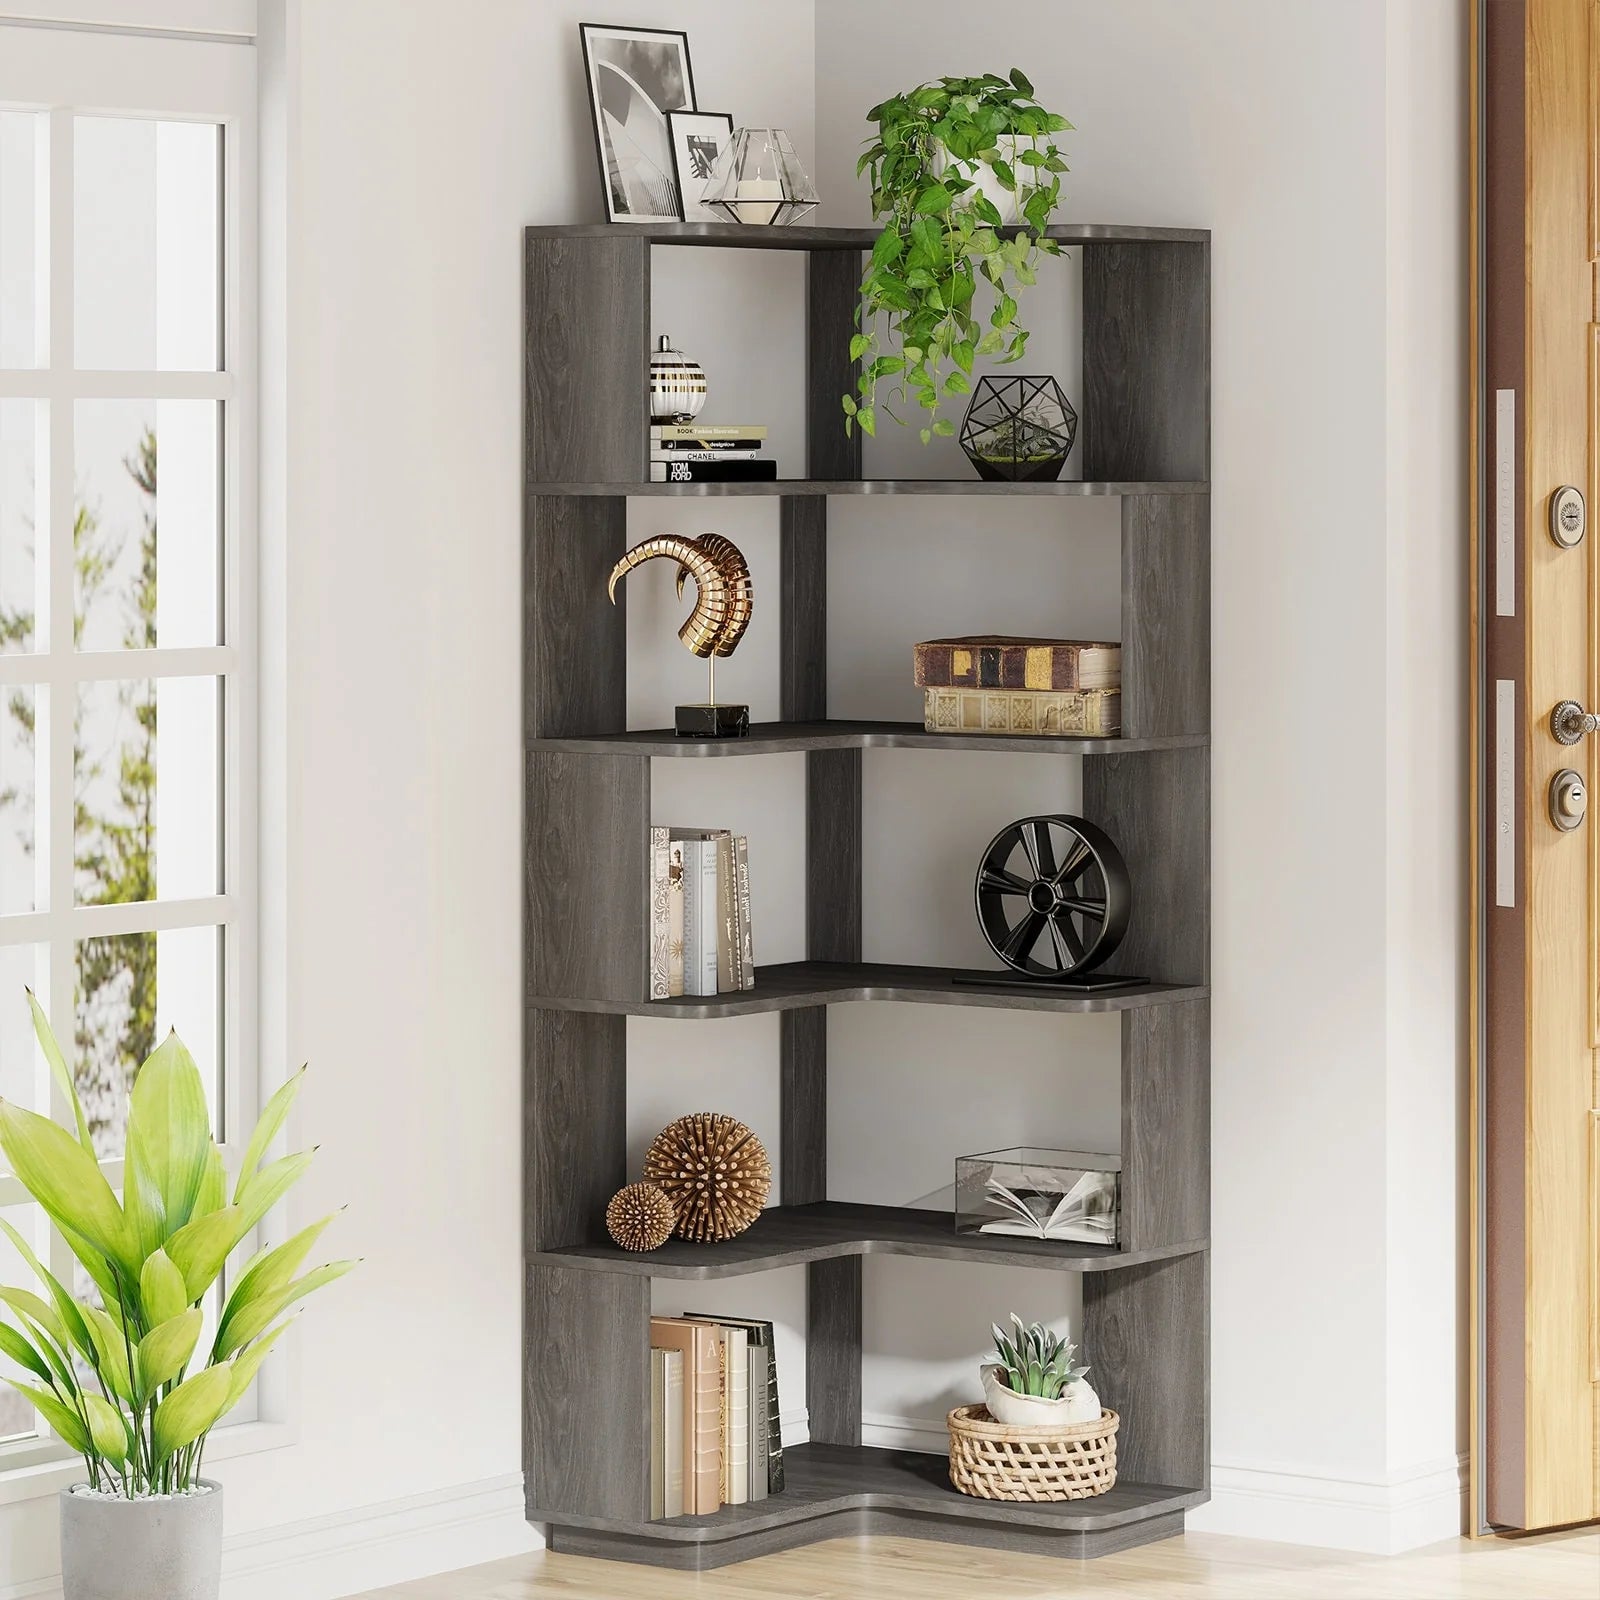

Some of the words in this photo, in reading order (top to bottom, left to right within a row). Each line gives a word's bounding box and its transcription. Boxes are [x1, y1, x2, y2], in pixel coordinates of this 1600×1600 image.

[671, 462, 689, 472] TOM
[671, 472, 692, 481] FORD
[706, 1340, 717, 1358] A
[757, 1383, 767, 1469] THUCYDIDES
